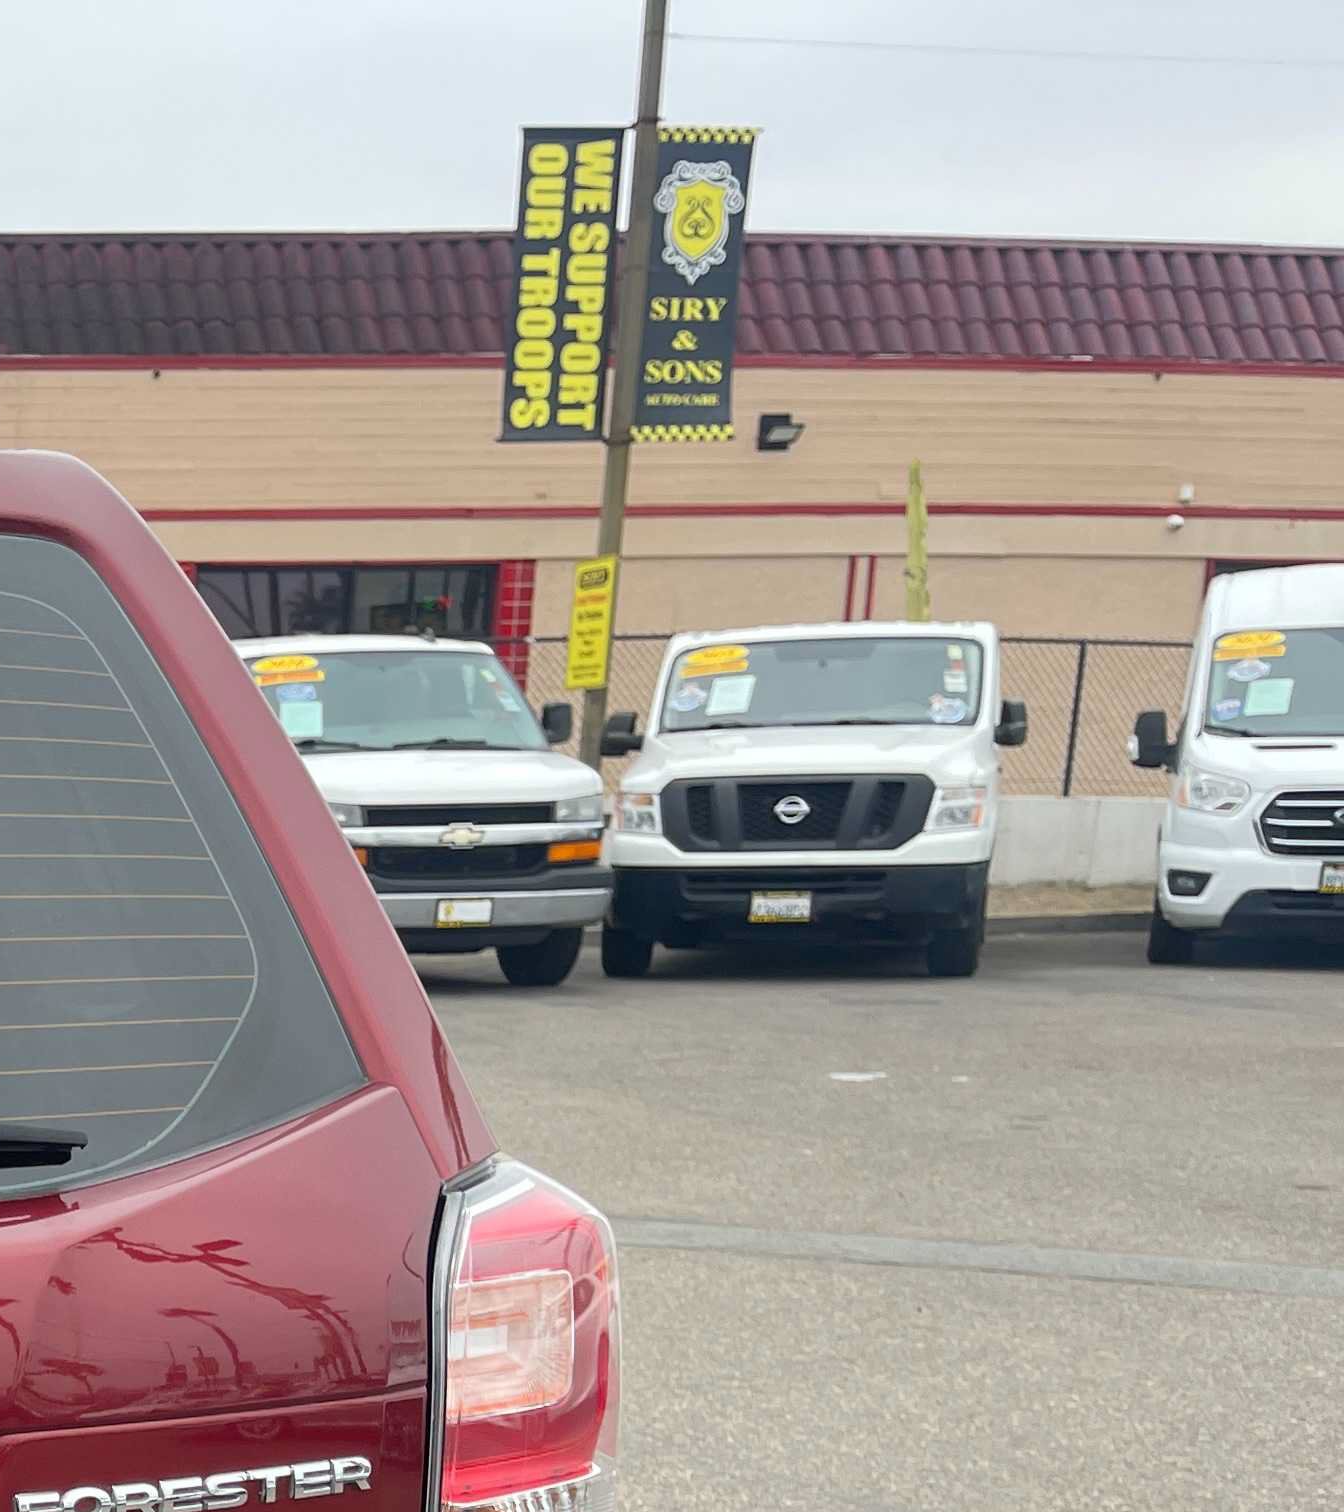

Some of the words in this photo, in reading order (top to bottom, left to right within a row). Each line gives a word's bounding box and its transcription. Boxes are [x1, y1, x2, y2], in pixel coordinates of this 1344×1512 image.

[523, 143, 569, 241] OUR
[572, 139, 616, 215] WE
[509, 247, 563, 430] TROOPS
[556, 222, 611, 431] SUPPORT
[649, 297, 728, 321] SIRY
[671, 329, 698, 351] &
[643, 360, 722, 384] SONS
